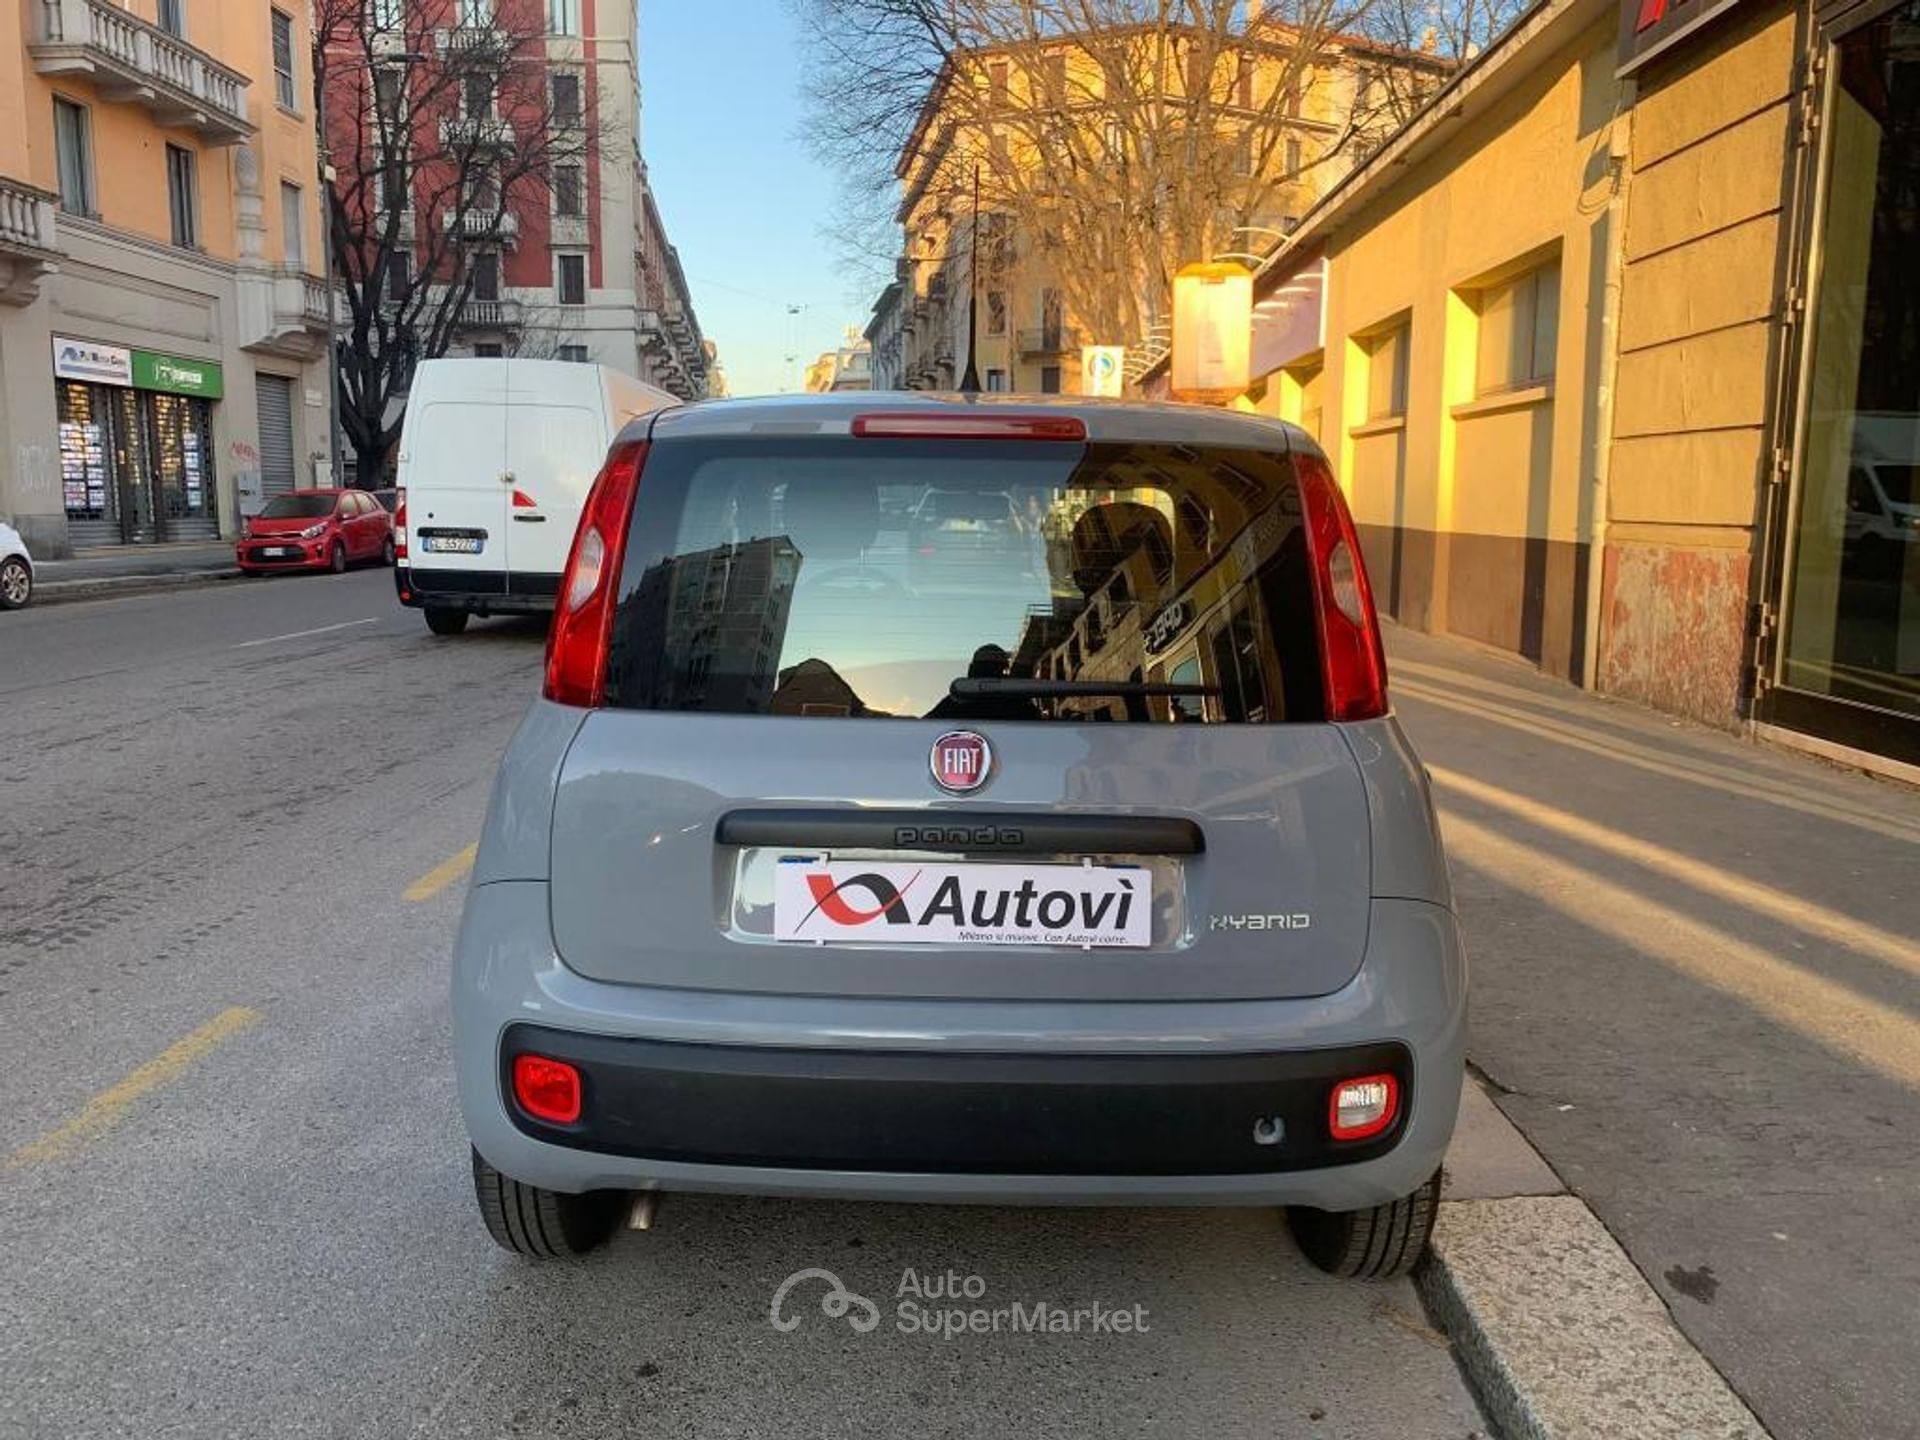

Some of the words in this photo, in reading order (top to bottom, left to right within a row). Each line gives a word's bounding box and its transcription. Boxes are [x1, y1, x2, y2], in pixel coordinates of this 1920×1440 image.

[944, 747, 979, 774] FIAT
[895, 825, 1024, 846] panda
[917, 875, 1134, 930] Autovì
[1209, 914, 1310, 931] HYBRID
[958, 931, 993, 942] Milano
[1044, 933, 1063, 943] Con
